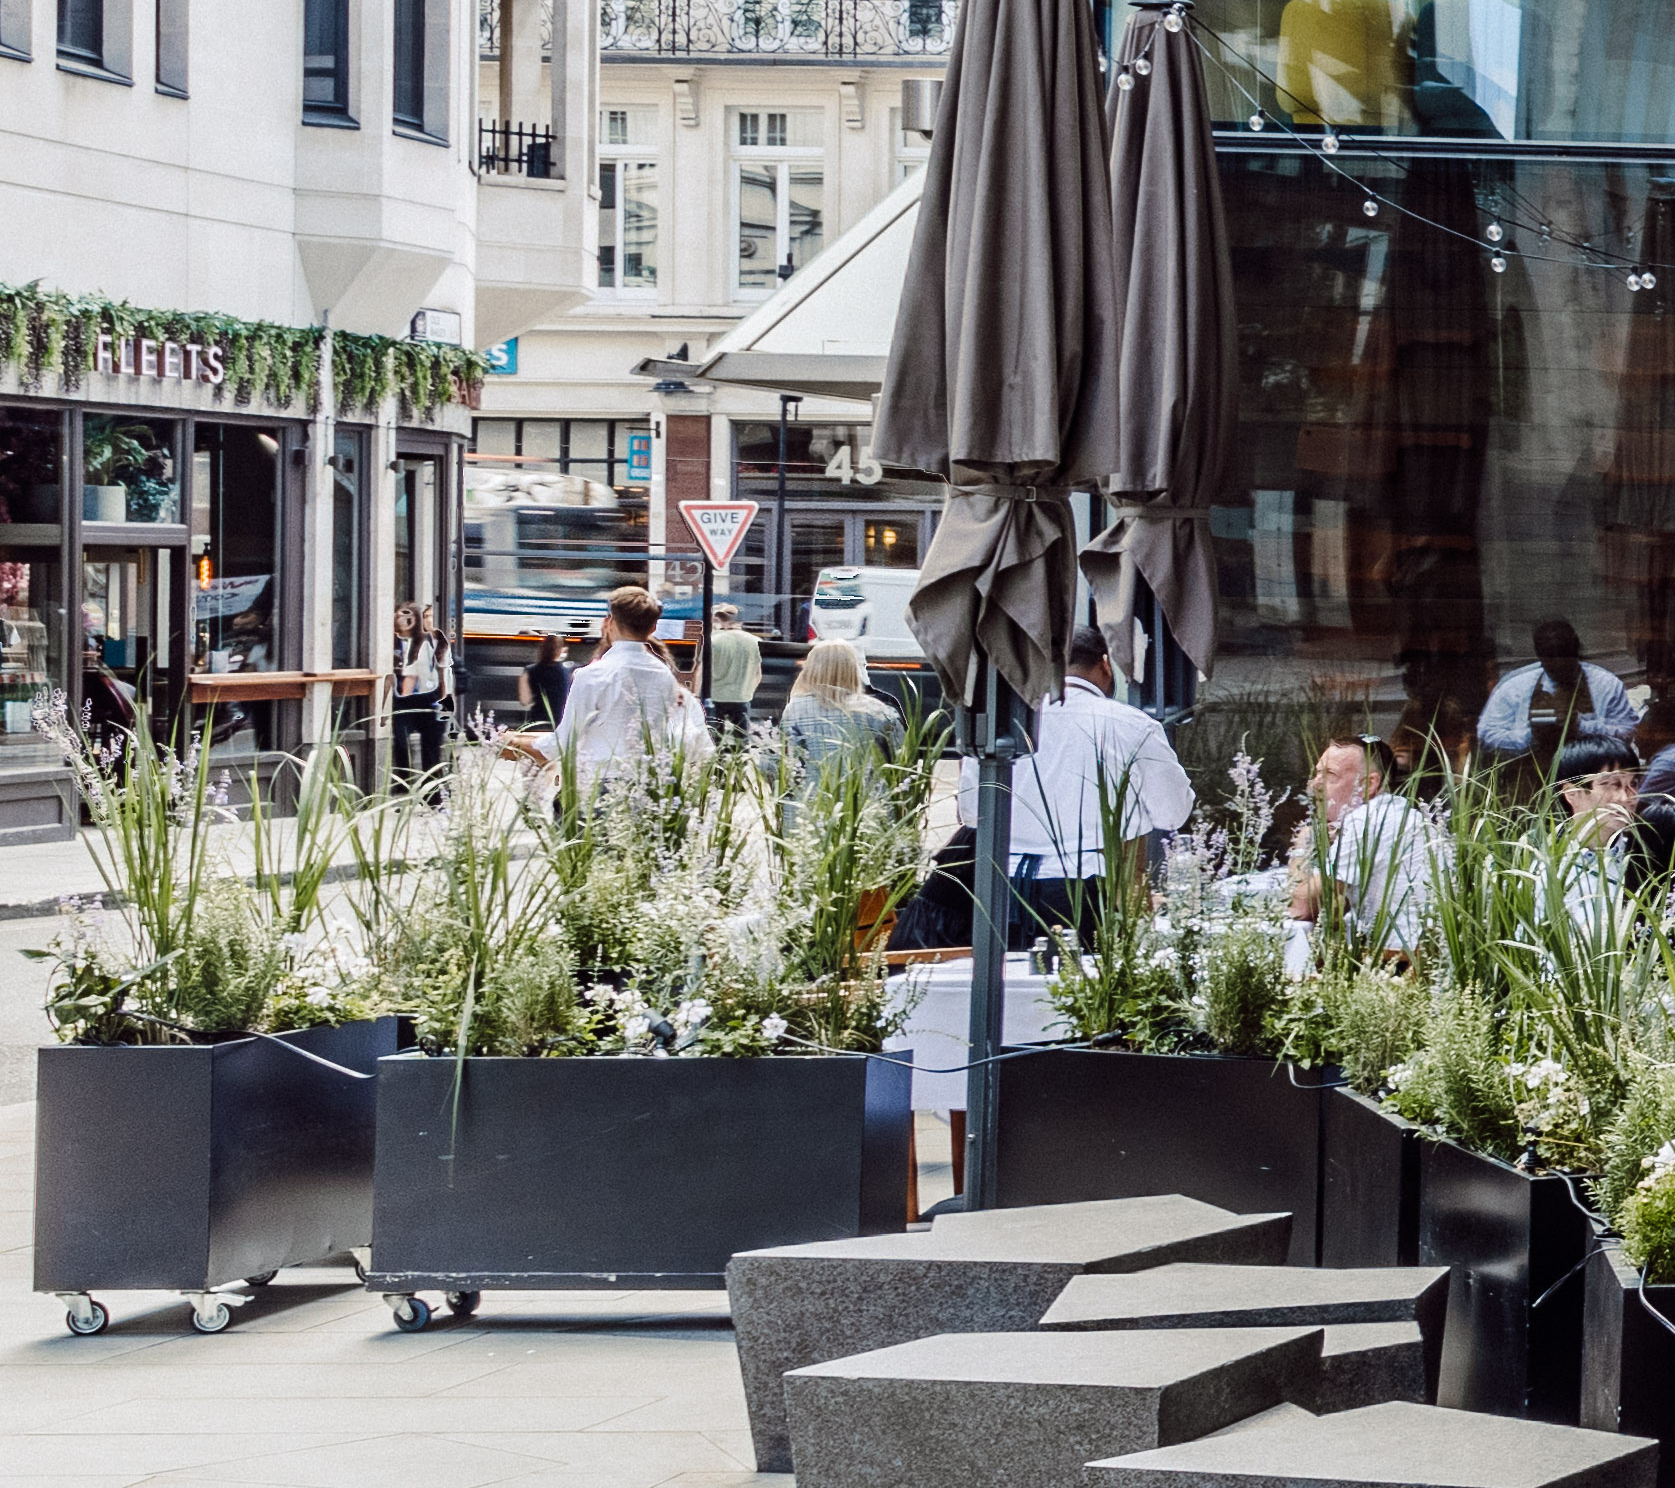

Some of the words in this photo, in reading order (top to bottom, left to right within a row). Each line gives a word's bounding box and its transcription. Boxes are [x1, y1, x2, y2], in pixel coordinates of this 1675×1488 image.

[96, 333, 224, 384] FLEETS
[825, 445, 883, 486] 45
[700, 512, 740, 524] GIVE
[709, 528, 733, 536] WAY
